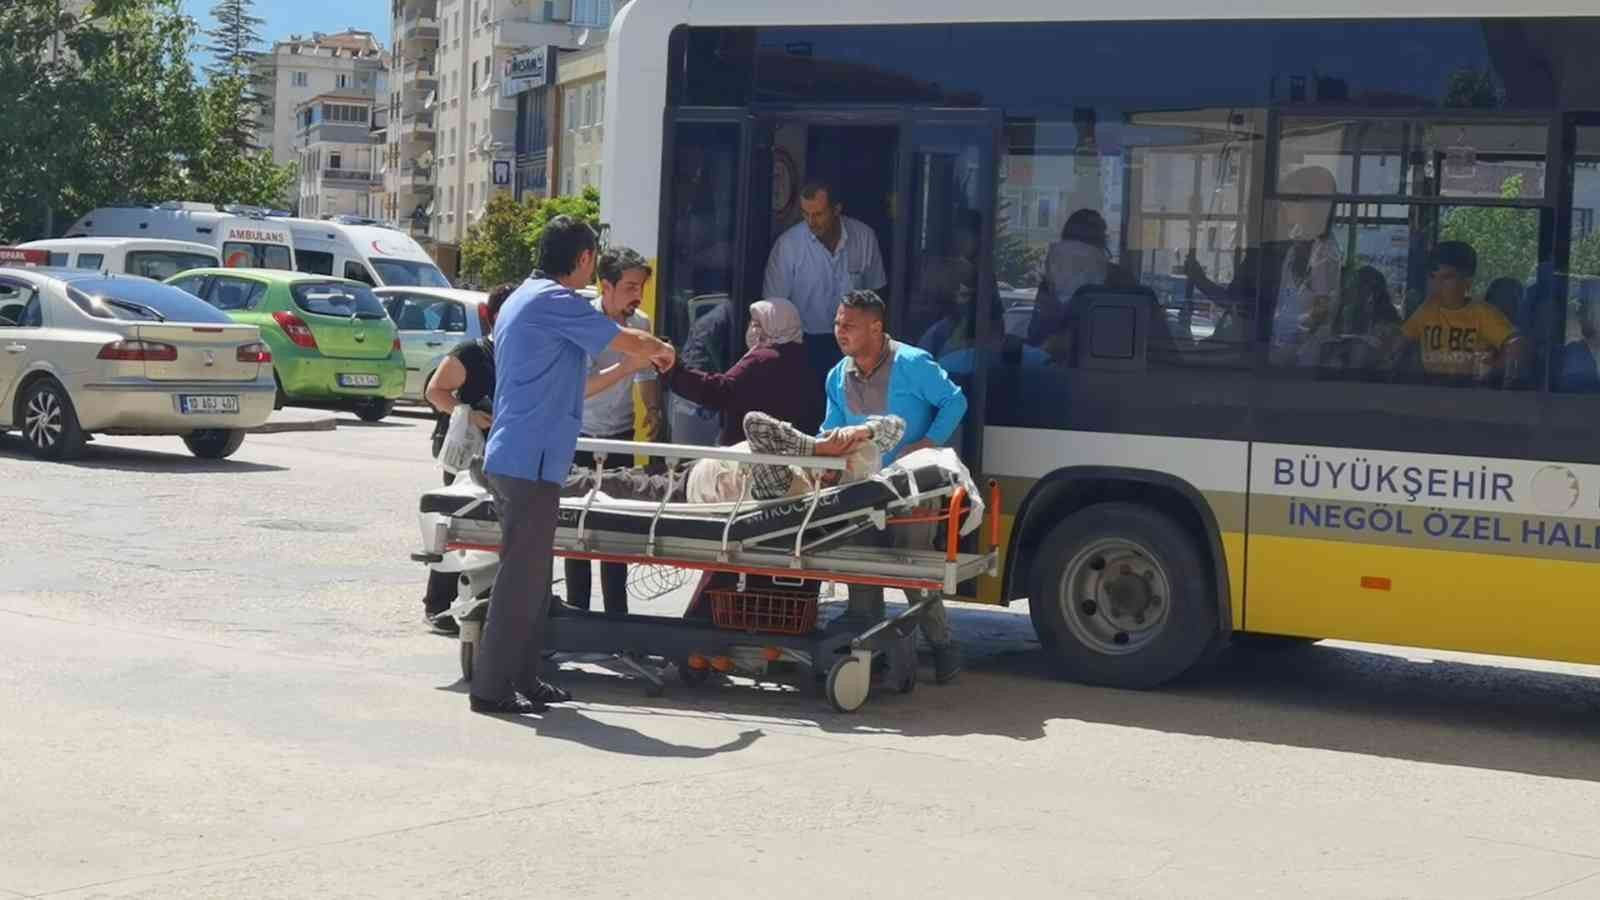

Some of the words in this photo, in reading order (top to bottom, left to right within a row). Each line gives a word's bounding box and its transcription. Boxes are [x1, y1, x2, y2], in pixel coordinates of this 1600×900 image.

[229, 229, 289, 242] AMBULANS
[1448, 326, 1477, 352] BE
[1274, 453, 1514, 503] BÜYÜKŞEHİR
[1288, 497, 1413, 535] İNEGÖL
[1423, 506, 1512, 543] ÖZEL
